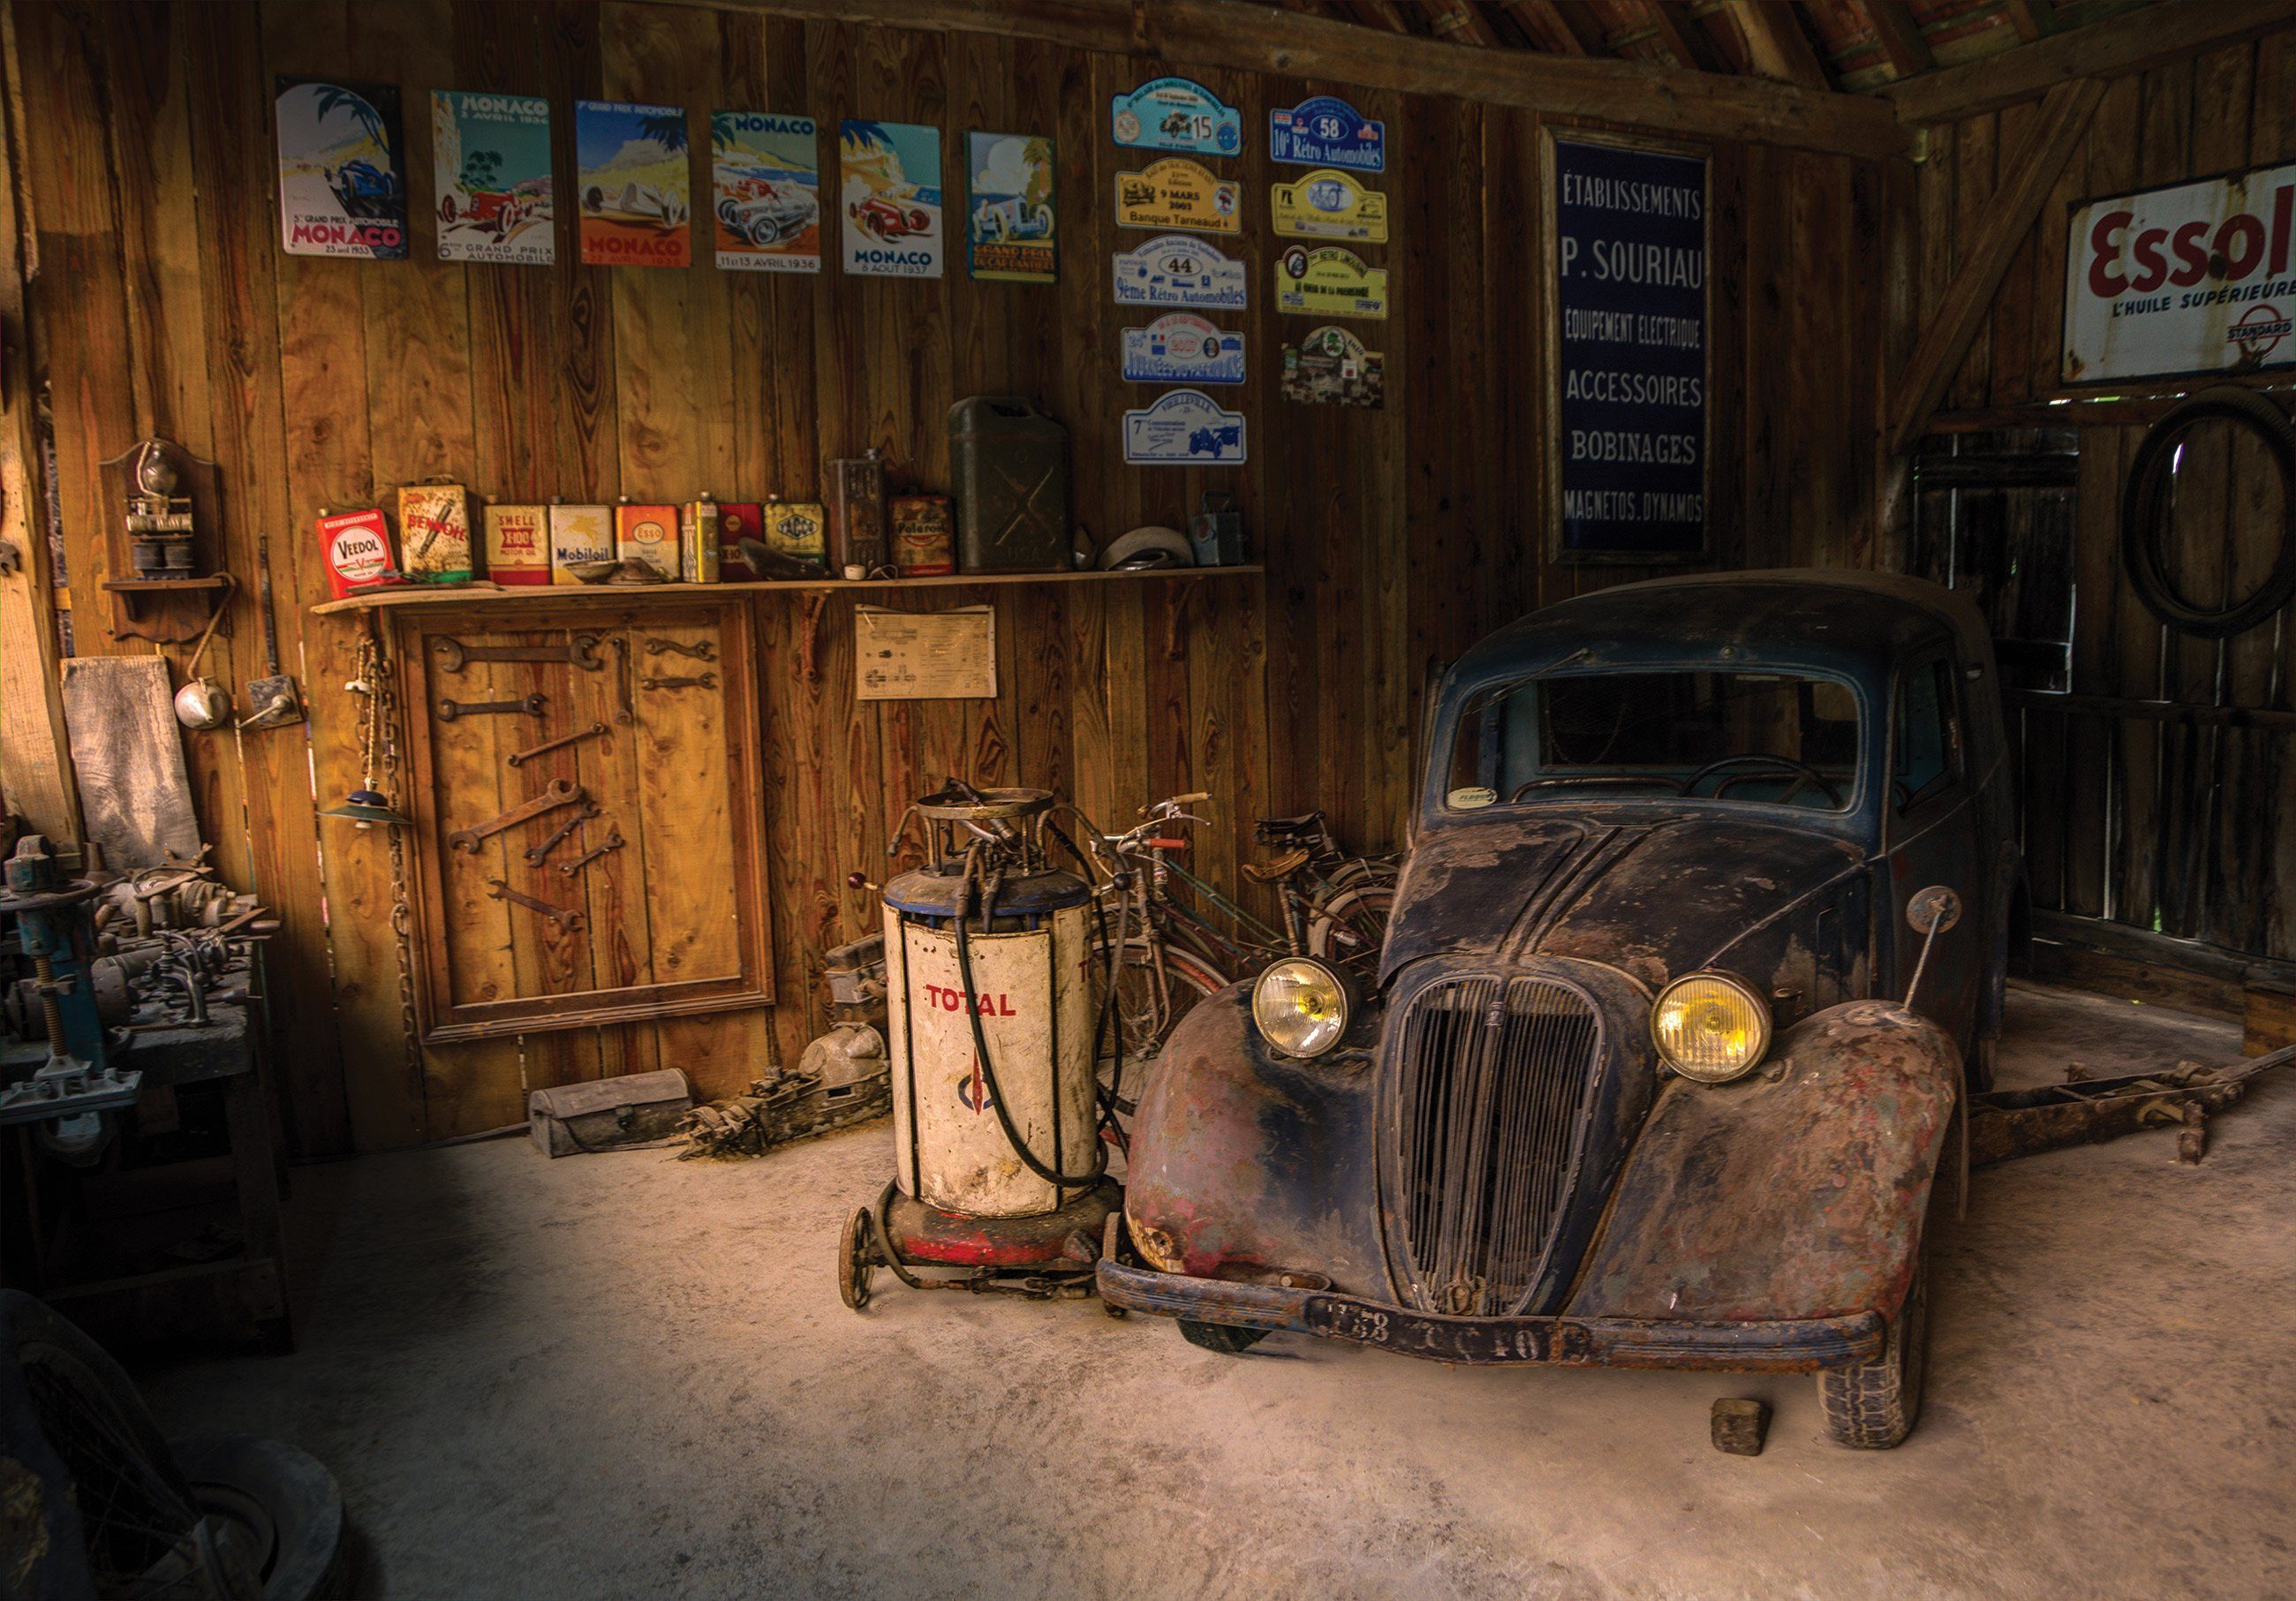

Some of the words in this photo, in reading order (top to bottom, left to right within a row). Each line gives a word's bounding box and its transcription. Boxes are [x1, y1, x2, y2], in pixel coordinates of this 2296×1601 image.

[462, 95, 549, 116] MONACO
[472, 112, 515, 123] AVRIL
[735, 116, 814, 135] MONACO
[1194, 116, 1212, 139] 15
[1320, 117, 1340, 138] 58
[1293, 134, 1321, 160] Rétro
[1324, 141, 1381, 167] Automobiles
[1170, 190, 1200, 200] MARS
[1563, 169, 1701, 220] ÉTABLISSEMENTS
[305, 215, 329, 223] GRAND
[331, 215, 347, 224] PRIX
[1130, 211, 1170, 225] Banque
[1174, 214, 1221, 227] Tarneaud
[291, 223, 402, 247] MONACO
[466, 243, 512, 253] GRAND
[519, 245, 553, 255] PRIX
[588, 236, 683, 256] MONACO
[467, 253, 553, 263] AUTOMOBILE
[609, 254, 643, 264] AVRIL
[720, 256, 729, 266] 11
[740, 256, 751, 267] 13
[753, 258, 787, 268] AVRIL
[789, 258, 815, 268] 1936
[855, 248, 933, 266] MONACO
[1169, 257, 1192, 274] 44
[1592, 238, 1703, 290] SOURIAU
[903, 265, 927, 275] 1937
[1150, 284, 1178, 301] Rétro
[1182, 284, 1245, 305] Automobiles
[2113, 296, 2171, 318] L'HUILE
[2179, 278, 2296, 310] SUPÉRIEURE
[1565, 305, 1634, 343] ÉQUIPEMENT
[2228, 321, 2292, 340] STANDARD
[1567, 368, 1703, 407] ACCESSOIRES
[1571, 429, 1696, 465] BOBINAGES
[498, 515, 536, 526] SHELL
[505, 531, 530, 545] X-100
[337, 540, 379, 559] VEEDOL
[557, 548, 609, 561] Mobiloil
